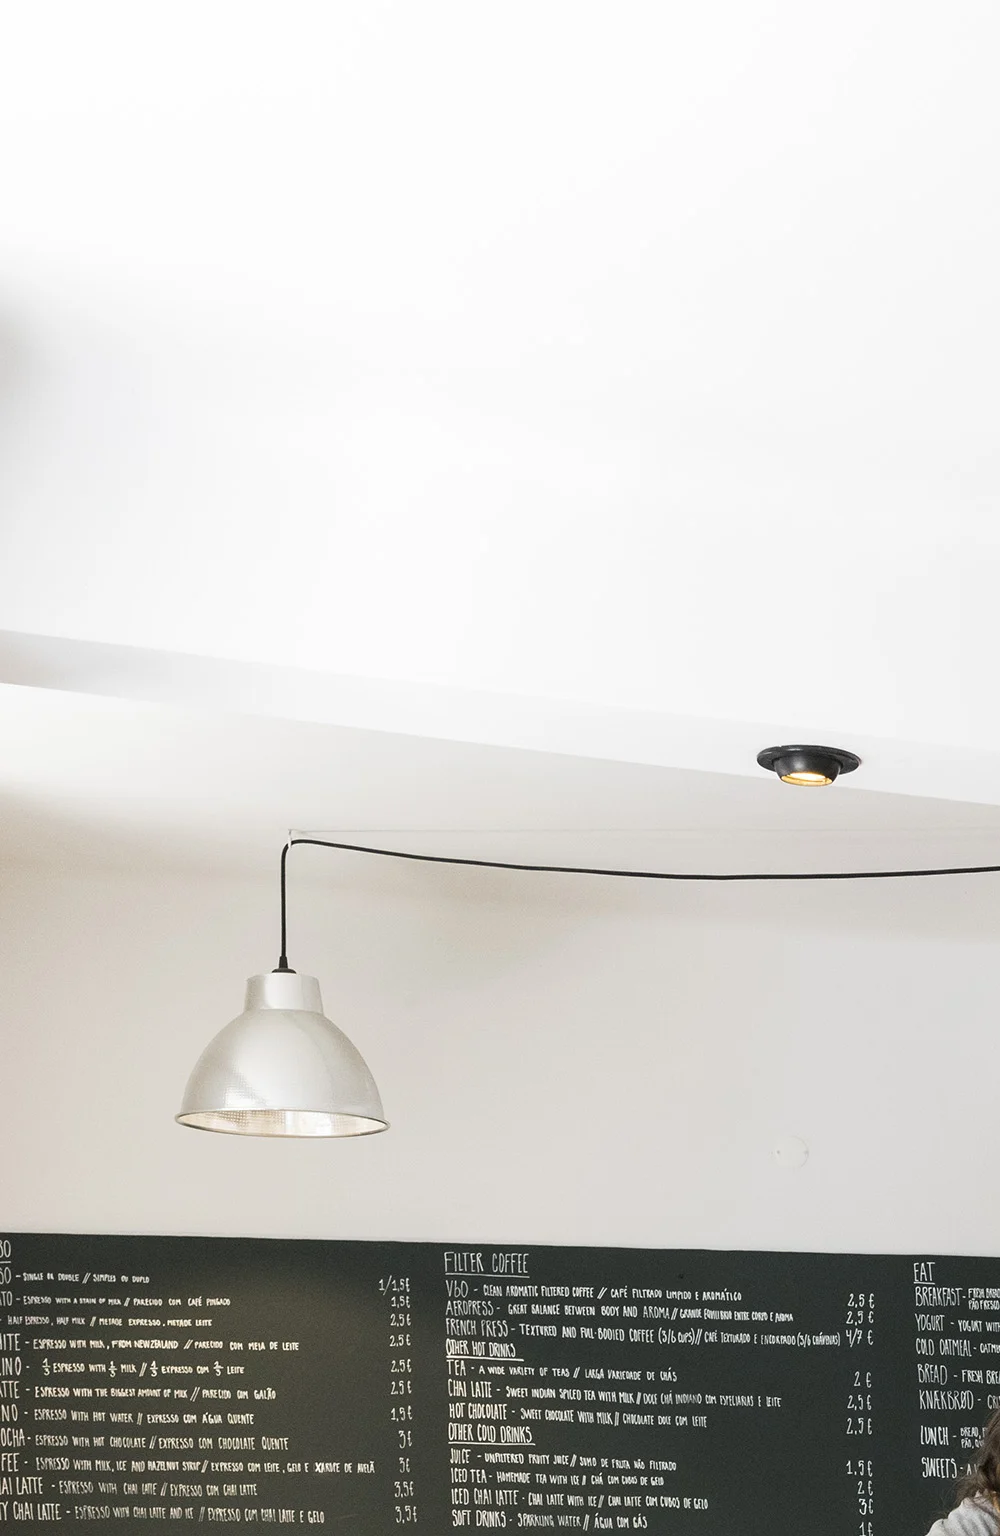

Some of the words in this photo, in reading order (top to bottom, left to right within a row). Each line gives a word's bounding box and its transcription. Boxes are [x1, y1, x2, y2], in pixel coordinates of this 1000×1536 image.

[444, 1252, 483, 1272] FILTER
[492, 1253, 529, 1273] COFFEE
[914, 1262, 935, 1281] EAT
[23, 1273, 43, 1281] SINGLE
[188, 1296, 202, 1306] CAFÉ
[484, 1285, 502, 1296] CLEAN
[506, 1286, 538, 1296] AROMATIC
[541, 1286, 569, 1297] FILTERED
[572, 1287, 594, 1298] COFFEE
[611, 1286, 627, 1298] CAFÉ
[632, 1289, 662, 1298] FILTRADO
[695, 1292, 698, 1300] E
[703, 1288, 741, 1301] AROMÁTICO
[915, 1286, 962, 1306] BREAKFAST
[446, 1300, 493, 1316] AEROPRESS
[508, 1304, 527, 1314] GREAT
[531, 1304, 560, 1314] BALANCE
[565, 1305, 595, 1315] BETWEEN
[601, 1306, 619, 1316] BODY
[623, 1306, 637, 1317] AND
[643, 1306, 670, 1319] AROMA
[446, 1318, 476, 1335] FRENCH
[481, 1320, 508, 1337] PRESS
[519, 1324, 557, 1336] TEXTURED
[562, 1326, 576, 1338] AND
[629, 1329, 654, 1343] COFFEE
[915, 1314, 944, 1331] YOGURT
[958, 1320, 982, 1332] YOGURT
[33, 1339, 66, 1349] ESPRESSO
[69, 1340, 86, 1348] WITH
[230, 1342, 243, 1350] COM
[248, 1342, 265, 1350] MEIA
[270, 1342, 278, 1350] DE
[282, 1342, 299, 1350] LEITE
[446, 1338, 469, 1355] OTHER
[472, 1341, 485, 1356] HOT
[489, 1342, 515, 1357] DRINKS
[916, 1338, 934, 1356] COLD
[940, 1339, 972, 1356] OATMEAL
[53, 1363, 85, 1372] ESPRESSO
[89, 1364, 106, 1372] WITH
[121, 1364, 136, 1372] MILK
[227, 1366, 244, 1374] LEITE
[447, 1359, 466, 1376] TEA
[479, 1366, 485, 1374] A
[509, 1367, 534, 1375] VARIETY
[540, 1368, 548, 1376] OF
[552, 1368, 569, 1377] TEAS
[585, 1369, 604, 1379] LARGA
[608, 1370, 641, 1380] VARIEDADE
[647, 1372, 654, 1380] DE
[660, 1367, 677, 1382] CHÁS
[918, 1363, 947, 1385] BREAD
[962, 1370, 983, 1383] FRESH
[35, 1387, 69, 1397] ESPRESSO
[73, 1388, 92, 1397] WITH
[95, 1389, 107, 1397] THE
[254, 1388, 276, 1400] GALÃO
[448, 1379, 466, 1397] CHAI
[471, 1381, 492, 1398] LATTE
[506, 1386, 528, 1397] SWEET
[532, 1388, 555, 1398] INDIAN
[919, 1390, 973, 1410] KNÆKBRØD
[34, 1409, 66, 1420] ESPRESSO
[71, 1410, 89, 1421] WITH
[93, 1412, 105, 1421] HOT
[110, 1413, 133, 1422] WATER
[147, 1414, 179, 1423] EXPRESSO
[228, 1413, 254, 1424] QUENTE
[449, 1403, 465, 1418] HOT
[468, 1403, 507, 1420] CHOCOLATE
[521, 1408, 541, 1419] SWEET
[577, 1411, 594, 1423] WITH
[597, 1412, 613, 1424] MILK
[692, 1416, 707, 1427] LEITE
[449, 1422, 473, 1441] OTHER
[477, 1424, 496, 1442] COLD
[500, 1426, 532, 1443] DRINKS
[921, 1426, 949, 1446] LUNCH
[218, 1437, 255, 1450] CHOCOLATE
[262, 1437, 288, 1450] QUENTE
[450, 1448, 471, 1464] JUICE
[485, 1453, 524, 1464] UNFILTERED
[580, 1457, 596, 1466] SUMO
[451, 1468, 467, 1483] ICED
[470, 1469, 487, 1483] TEA
[549, 1475, 567, 1484] WITH
[571, 1475, 579, 1485] ICE
[591, 1473, 603, 1484] CHÁ
[922, 1457, 957, 1478] SWEETS
[16, 1477, 42, 1495] LATTE
[59, 1481, 93, 1494] ESPRESSO
[451, 1488, 469, 1505] ICED
[474, 1488, 492, 1504] CHAI
[496, 1490, 519, 1506] LATTE
[646, 1496, 658, 1506] COM
[660, 1496, 680, 1508] CUBOS
[694, 1498, 708, 1509] GELO
[13, 1501, 33, 1520] CHAI
[38, 1503, 61, 1520] LATTE
[308, 1511, 324, 1523] GELO
[452, 1509, 471, 1526] SOFT
[476, 1510, 506, 1527] DRINKS
[518, 1513, 554, 1527] SPARKLING
[557, 1516, 581, 1526] WATER
[594, 1513, 613, 1528] ÁGUA
[617, 1516, 629, 1528] COM
[633, 1514, 647, 1528] GÁS
